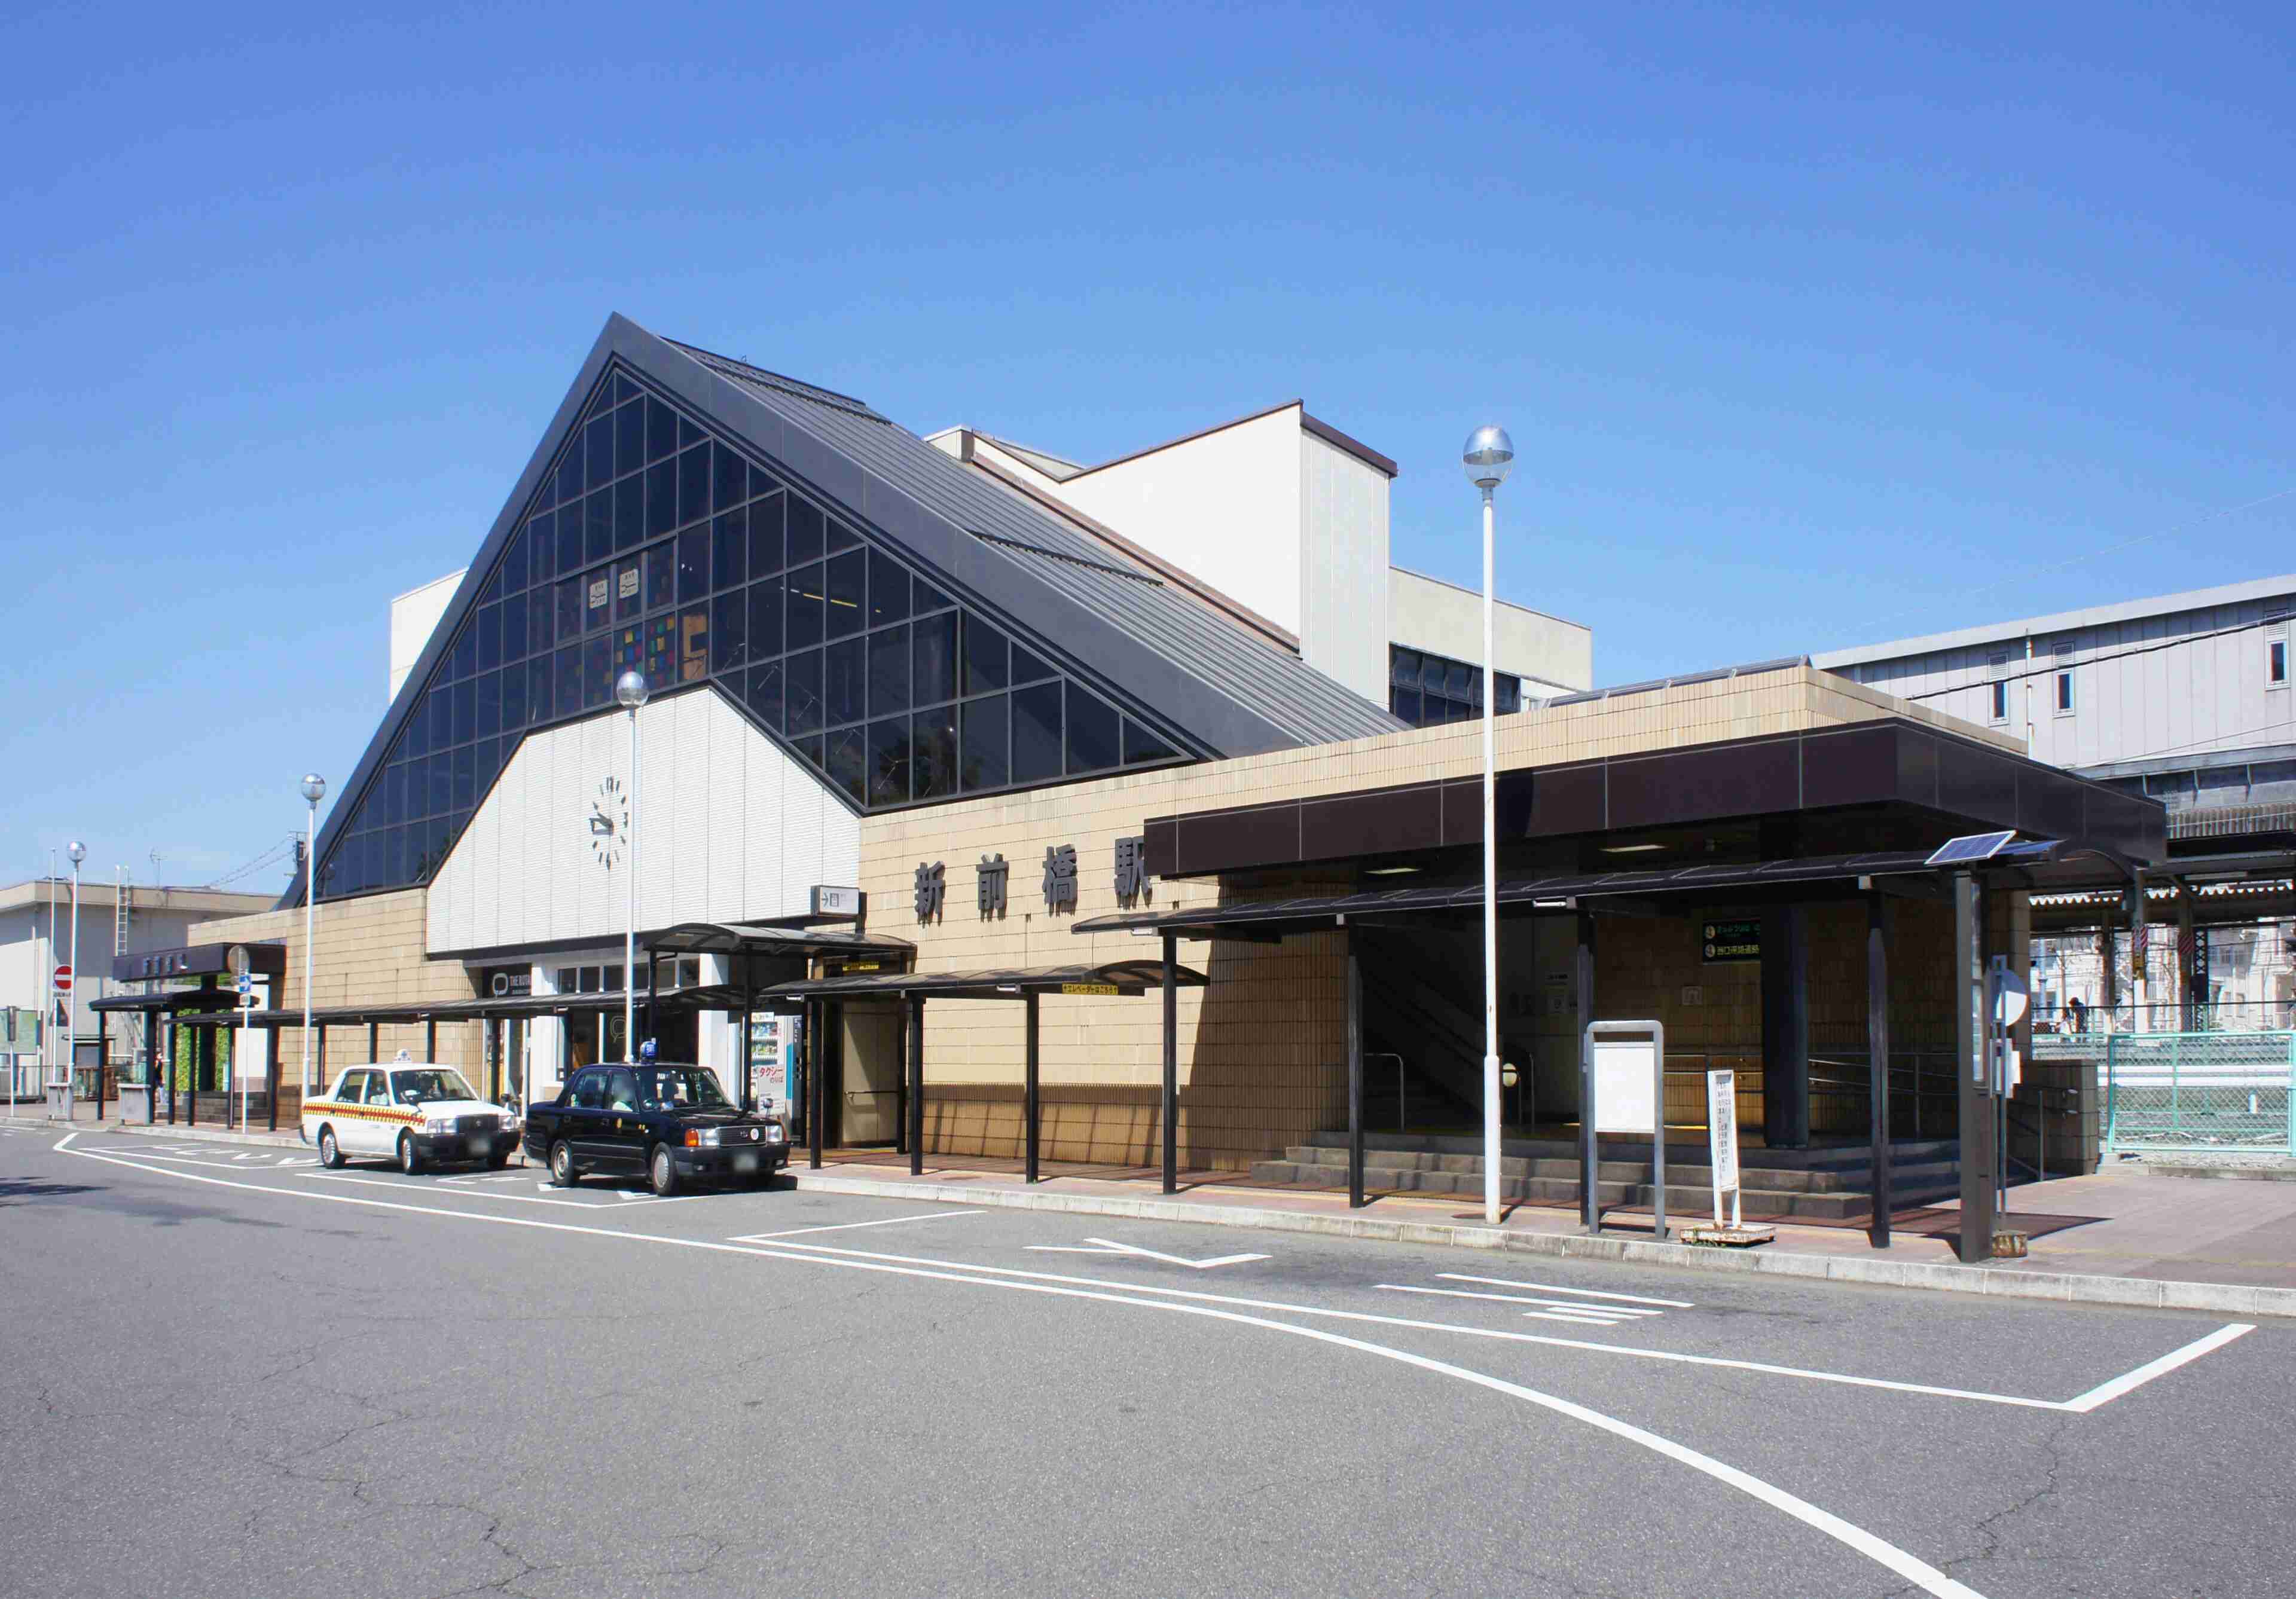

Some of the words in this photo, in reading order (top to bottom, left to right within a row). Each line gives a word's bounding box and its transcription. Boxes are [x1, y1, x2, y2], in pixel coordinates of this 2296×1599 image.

[915, 835, 1153, 916] 新前橋駅
[759, 1067, 783, 1077] タクシー
